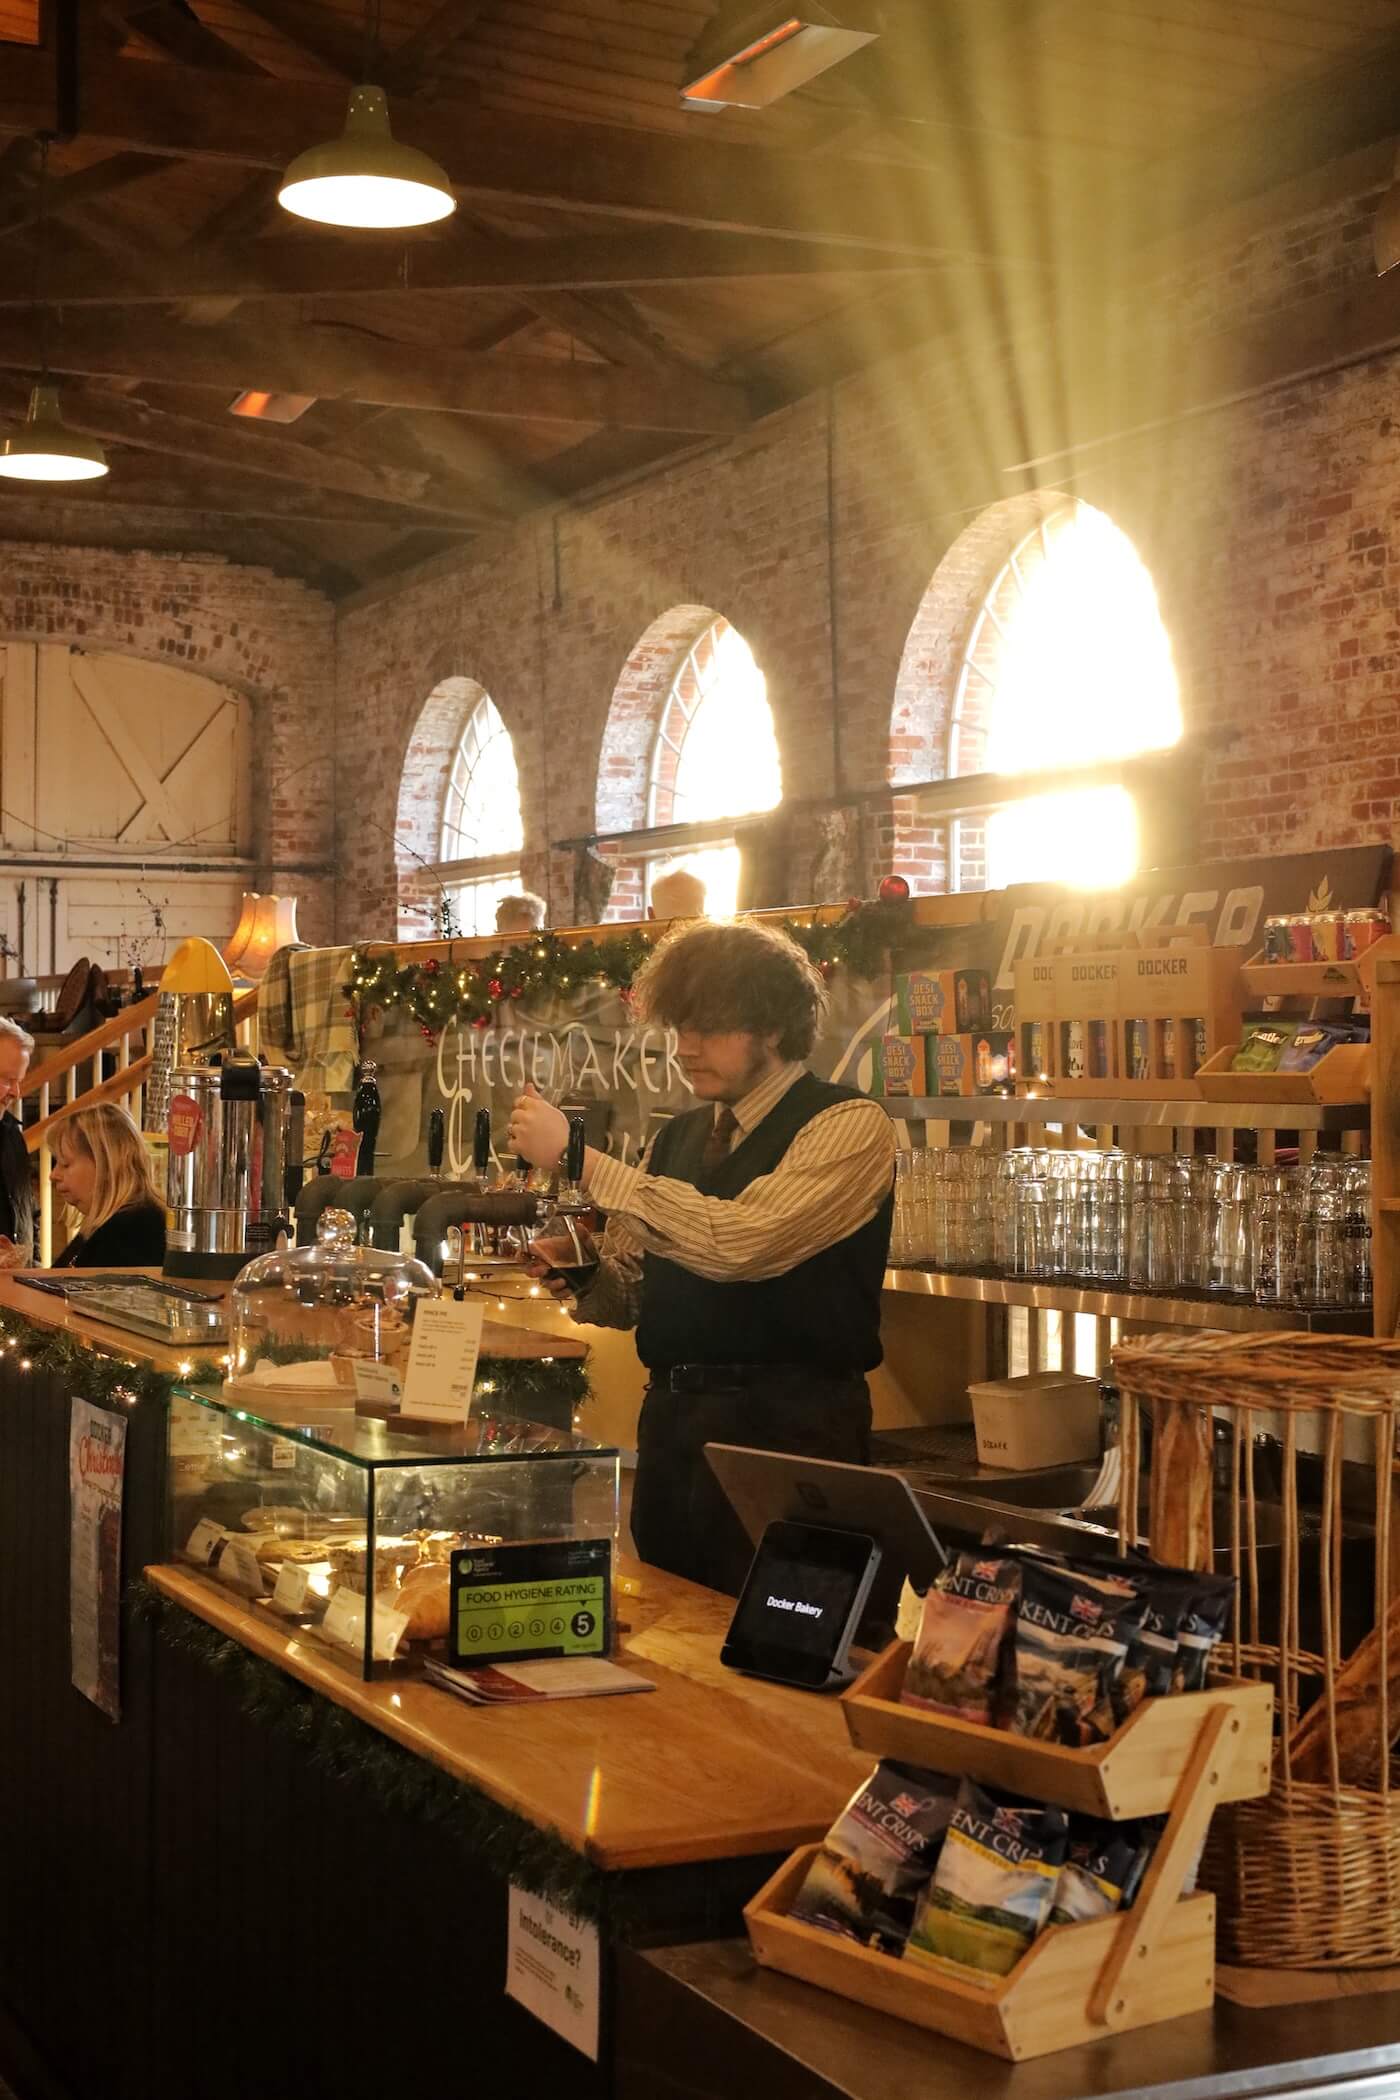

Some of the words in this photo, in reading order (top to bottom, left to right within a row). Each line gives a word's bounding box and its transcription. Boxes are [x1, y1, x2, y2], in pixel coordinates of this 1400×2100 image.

[1138, 959, 1188, 976] DOCKER
[913, 983, 934, 994] DESI
[911, 994, 938, 1007] SNACK
[916, 1005, 934, 1016] BOX
[886, 1045, 905, 1056] DESI
[883, 1056, 910, 1067] SNACK
[888, 1066, 905, 1078] BOX
[466, 1591, 501, 1604] FOOD
[504, 1588, 553, 1602] HYGIENE
[555, 1584, 596, 1597] RATING
[766, 1596, 795, 1611] Docker
[794, 1602, 823, 1618] Bakery
[576, 1615, 590, 1634] 5
[1019, 1600, 1074, 1634] KENT
[881, 1813, 929, 1851] CRISPS
